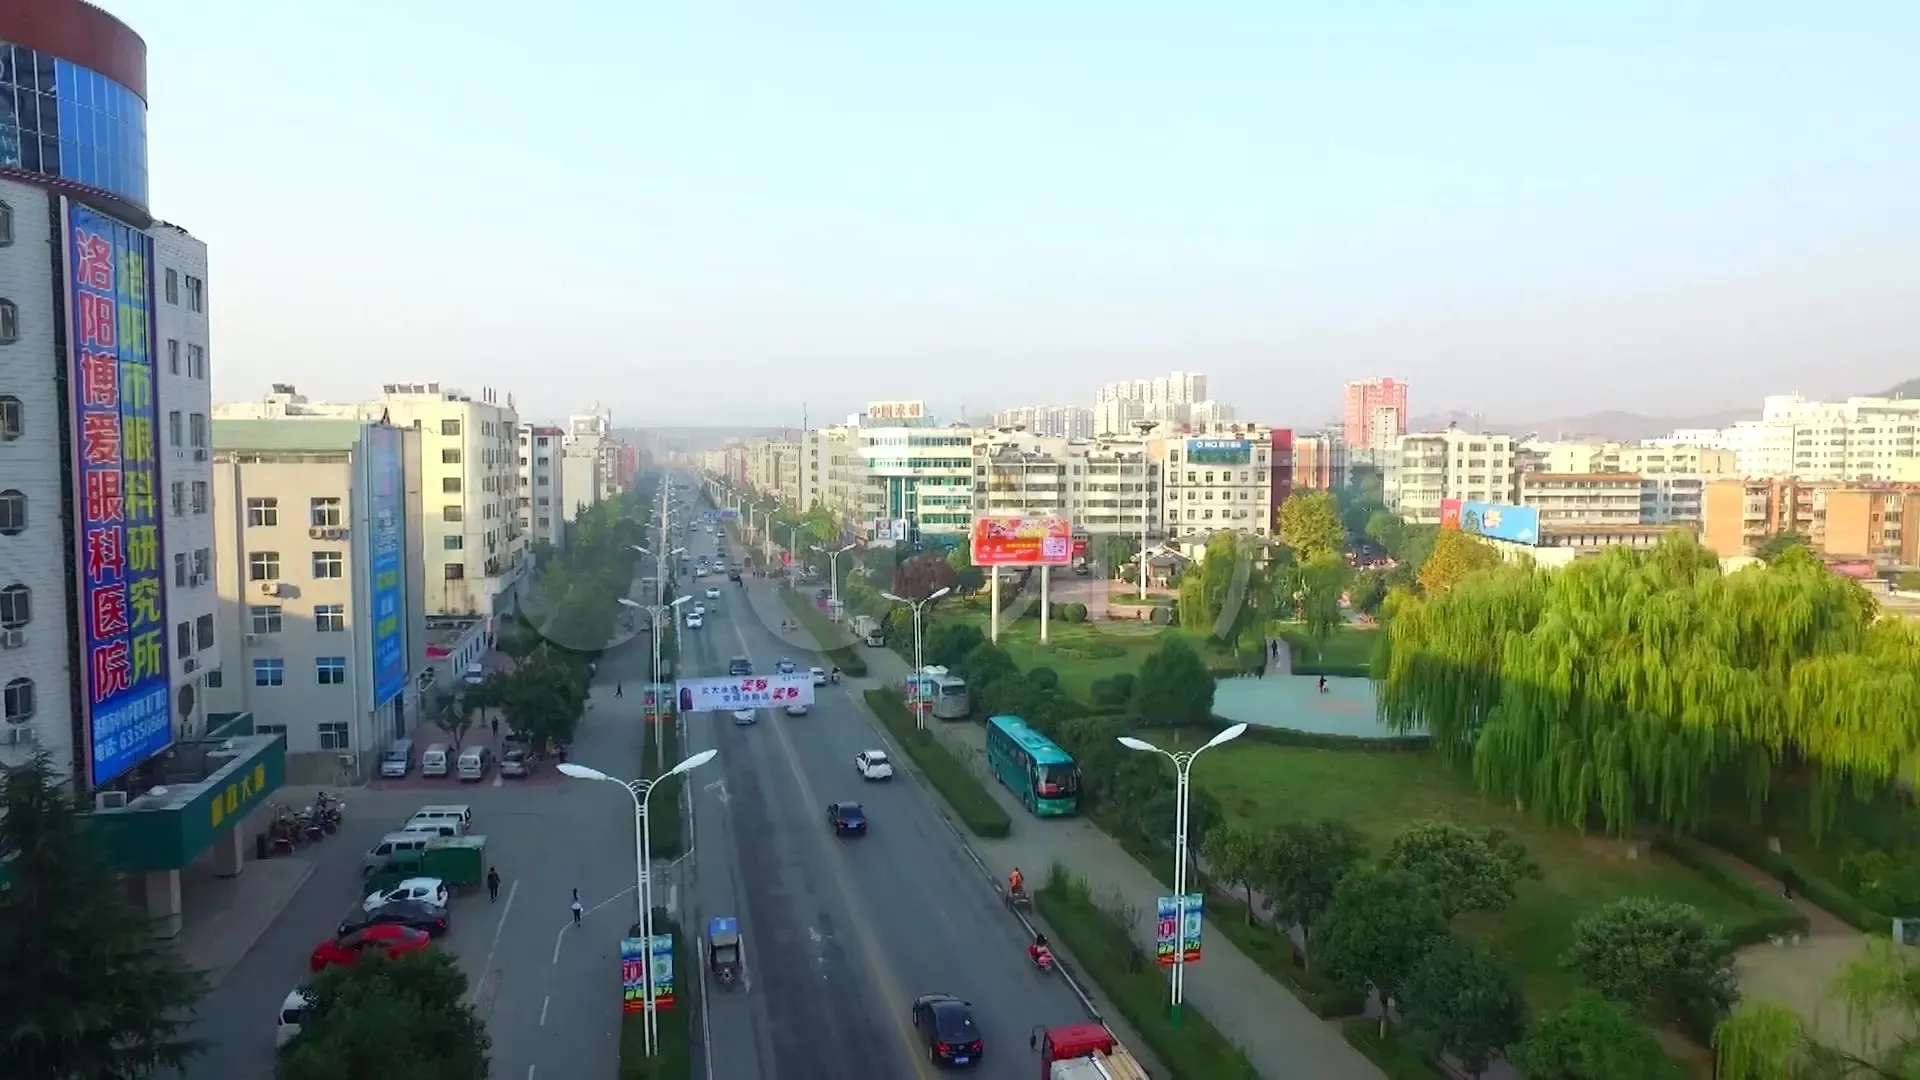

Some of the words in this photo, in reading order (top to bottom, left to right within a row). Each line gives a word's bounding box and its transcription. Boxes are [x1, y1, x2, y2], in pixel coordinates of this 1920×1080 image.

[75, 227, 131, 704] 洛阳博爱眼科医院
[117, 250, 162, 686] 洛阳市眼科研究所
